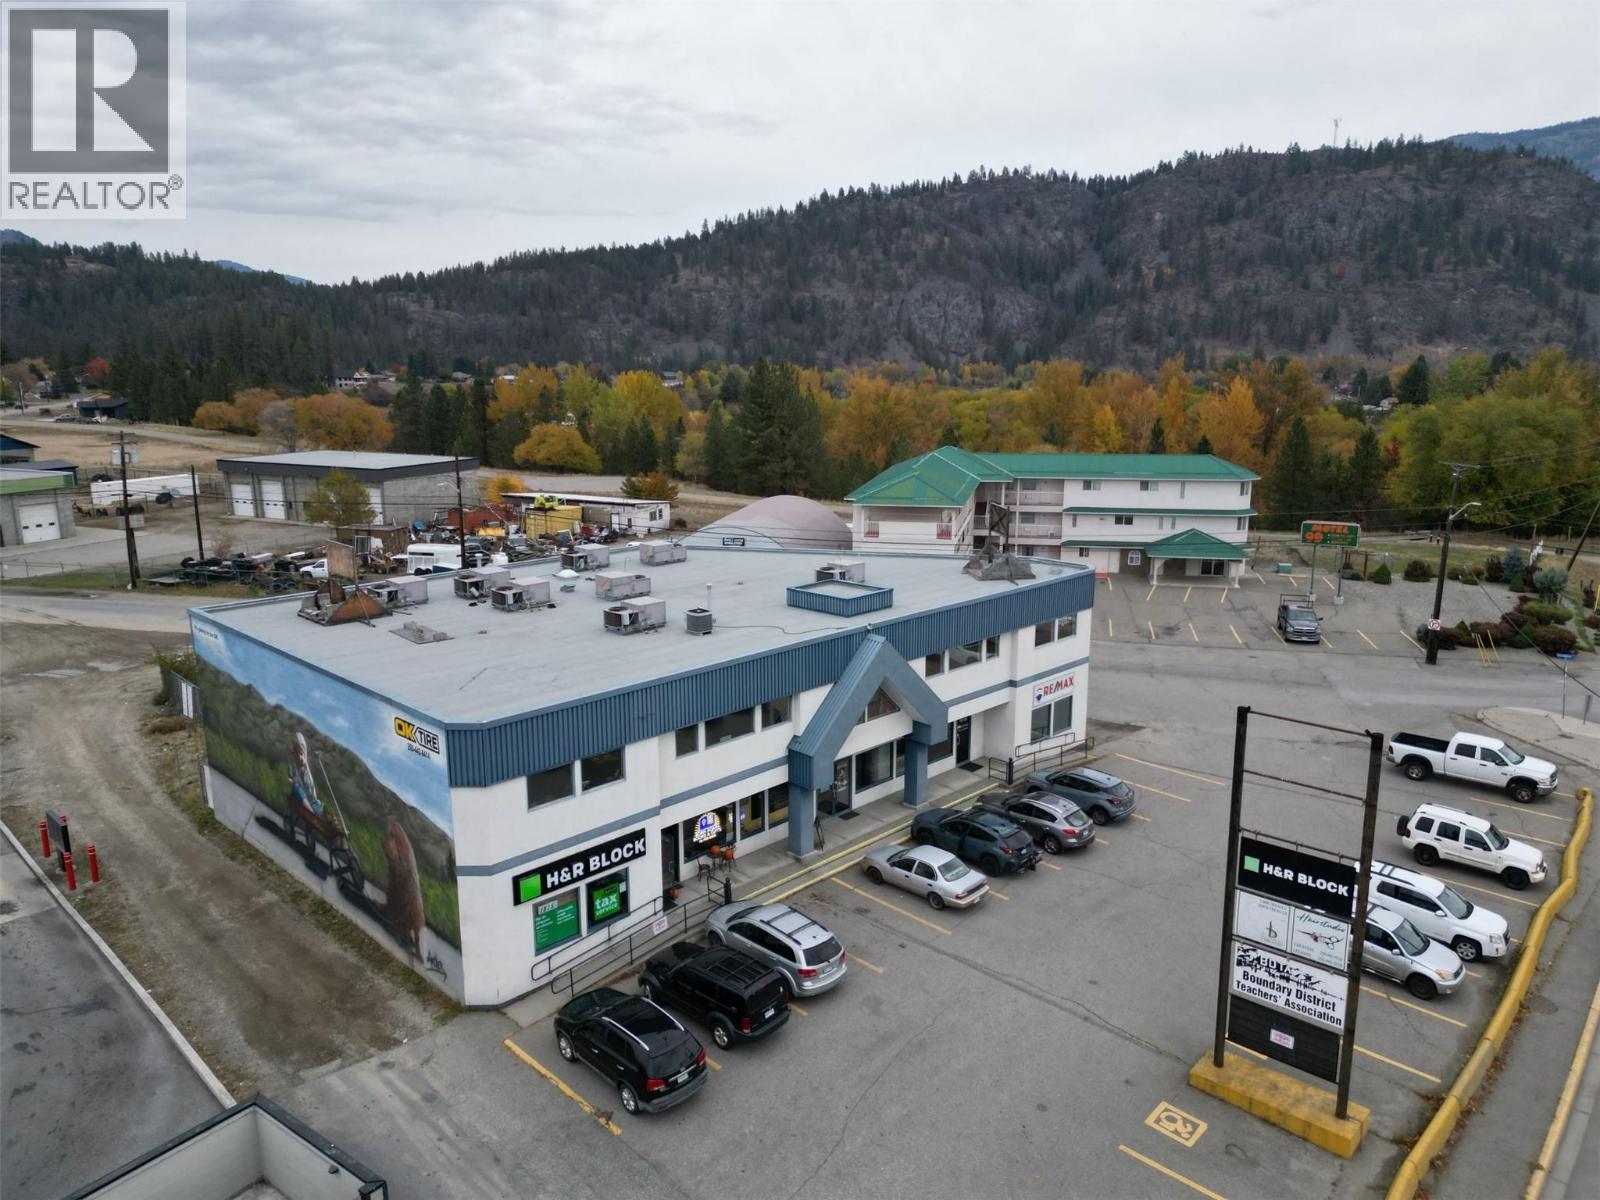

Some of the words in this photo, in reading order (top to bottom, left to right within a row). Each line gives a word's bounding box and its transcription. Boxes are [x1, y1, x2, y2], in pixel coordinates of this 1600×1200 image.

[1043, 676, 1074, 696] RE/MAX
[395, 717, 415, 742] OK
[418, 730, 438, 751] TIRE
[546, 862, 585, 889] H&R
[589, 838, 645, 871] BLOCK
[1263, 863, 1294, 881] H&R
[1297, 873, 1349, 897] BLOCK
[595, 894, 617, 910] tax
[1236, 980, 1282, 1003] Teachers'
[1284, 999, 1342, 1026] Association
[1242, 970, 1293, 997] Boundary
[1296, 989, 1336, 1012] District
